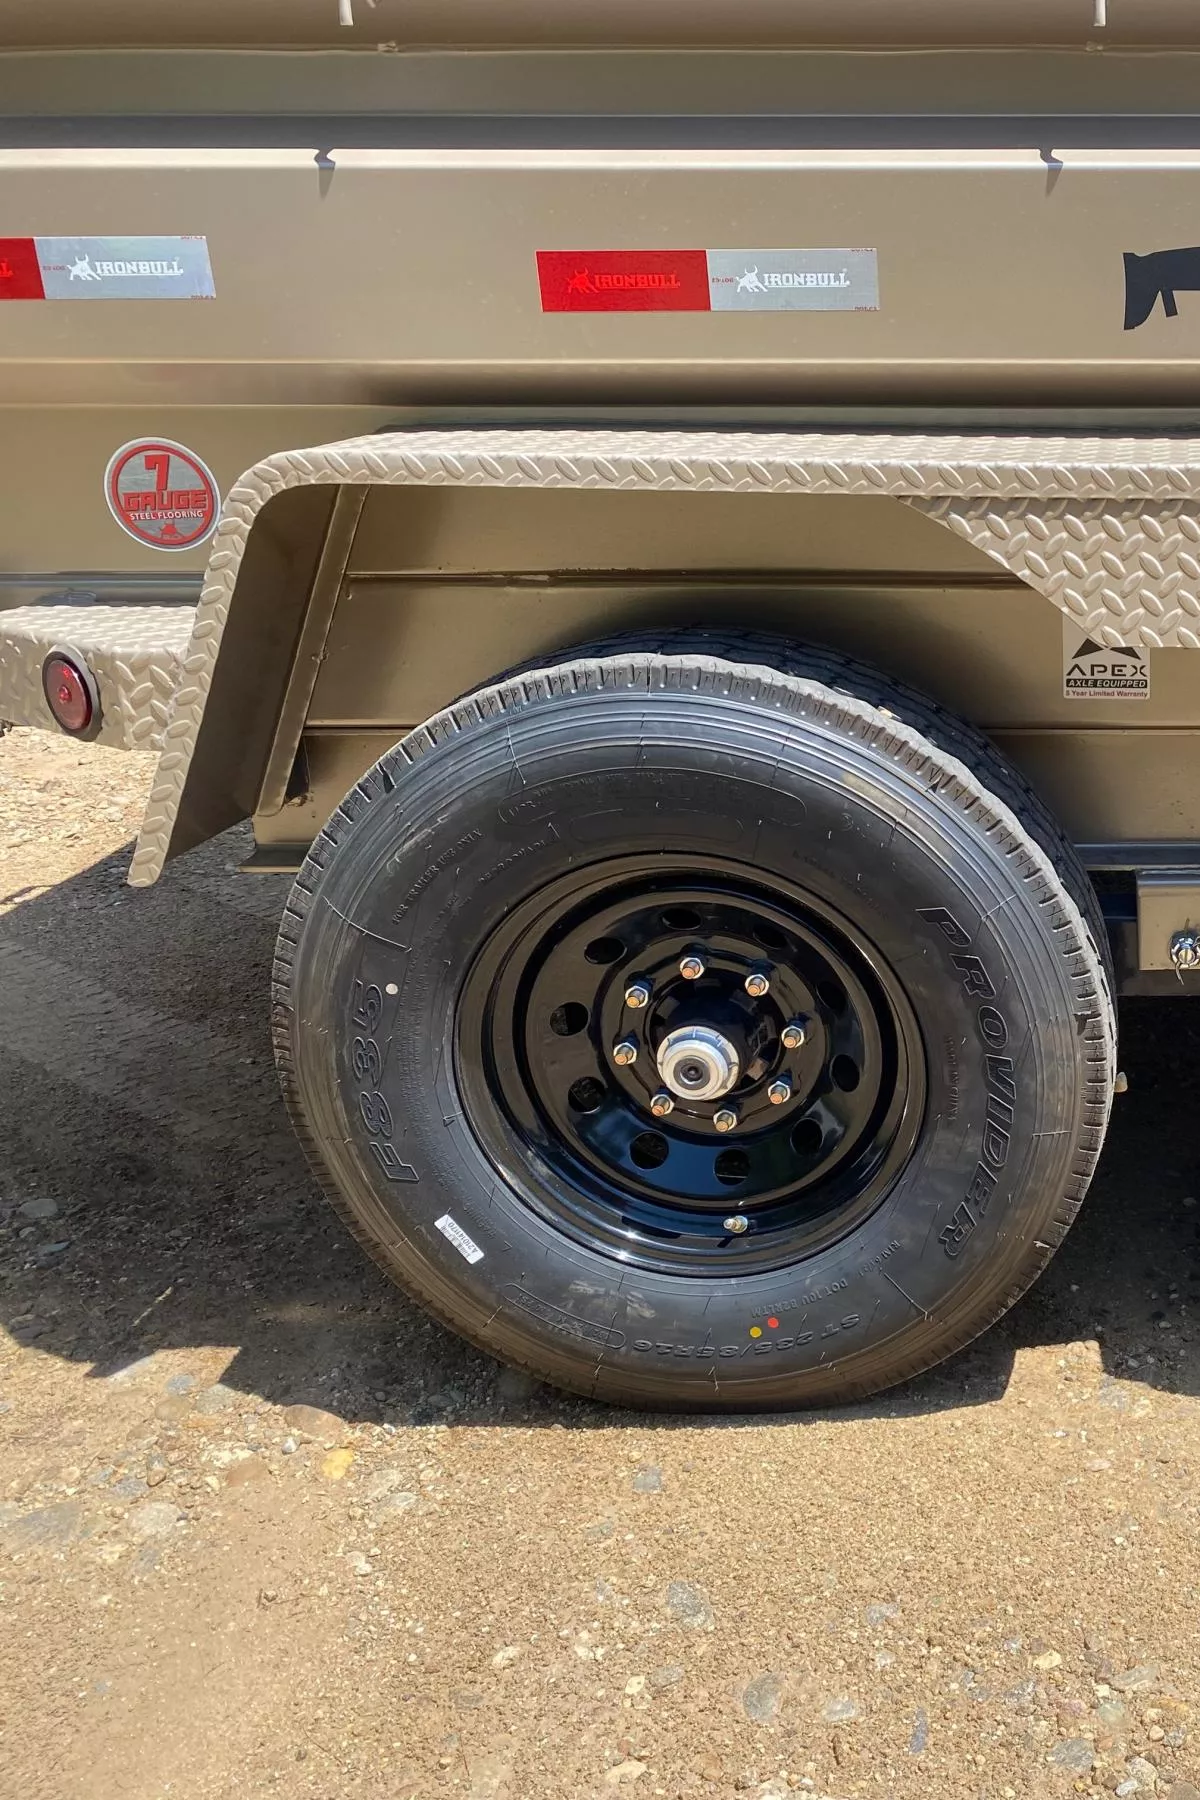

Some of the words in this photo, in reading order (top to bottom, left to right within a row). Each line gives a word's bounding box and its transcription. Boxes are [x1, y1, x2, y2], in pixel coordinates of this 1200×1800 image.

[95, 261, 184, 276] IRONBULL
[594, 272, 681, 288] IRONBULL
[763, 272, 850, 288] IRONBULL
[144, 453, 170, 490] 7
[122, 489, 207, 511] GAUGE
[130, 511, 156, 520] STEEL
[158, 510, 204, 519] FLOORING
[1066, 663, 1147, 677] APEX
[1097, 680, 1146, 688] EQUIPPED
[1117, 690, 1148, 698] Warranty
[350, 977, 420, 1185] F835
[914, 905, 1018, 1258] PROVIDER
[821, 1312, 861, 1340] ST
